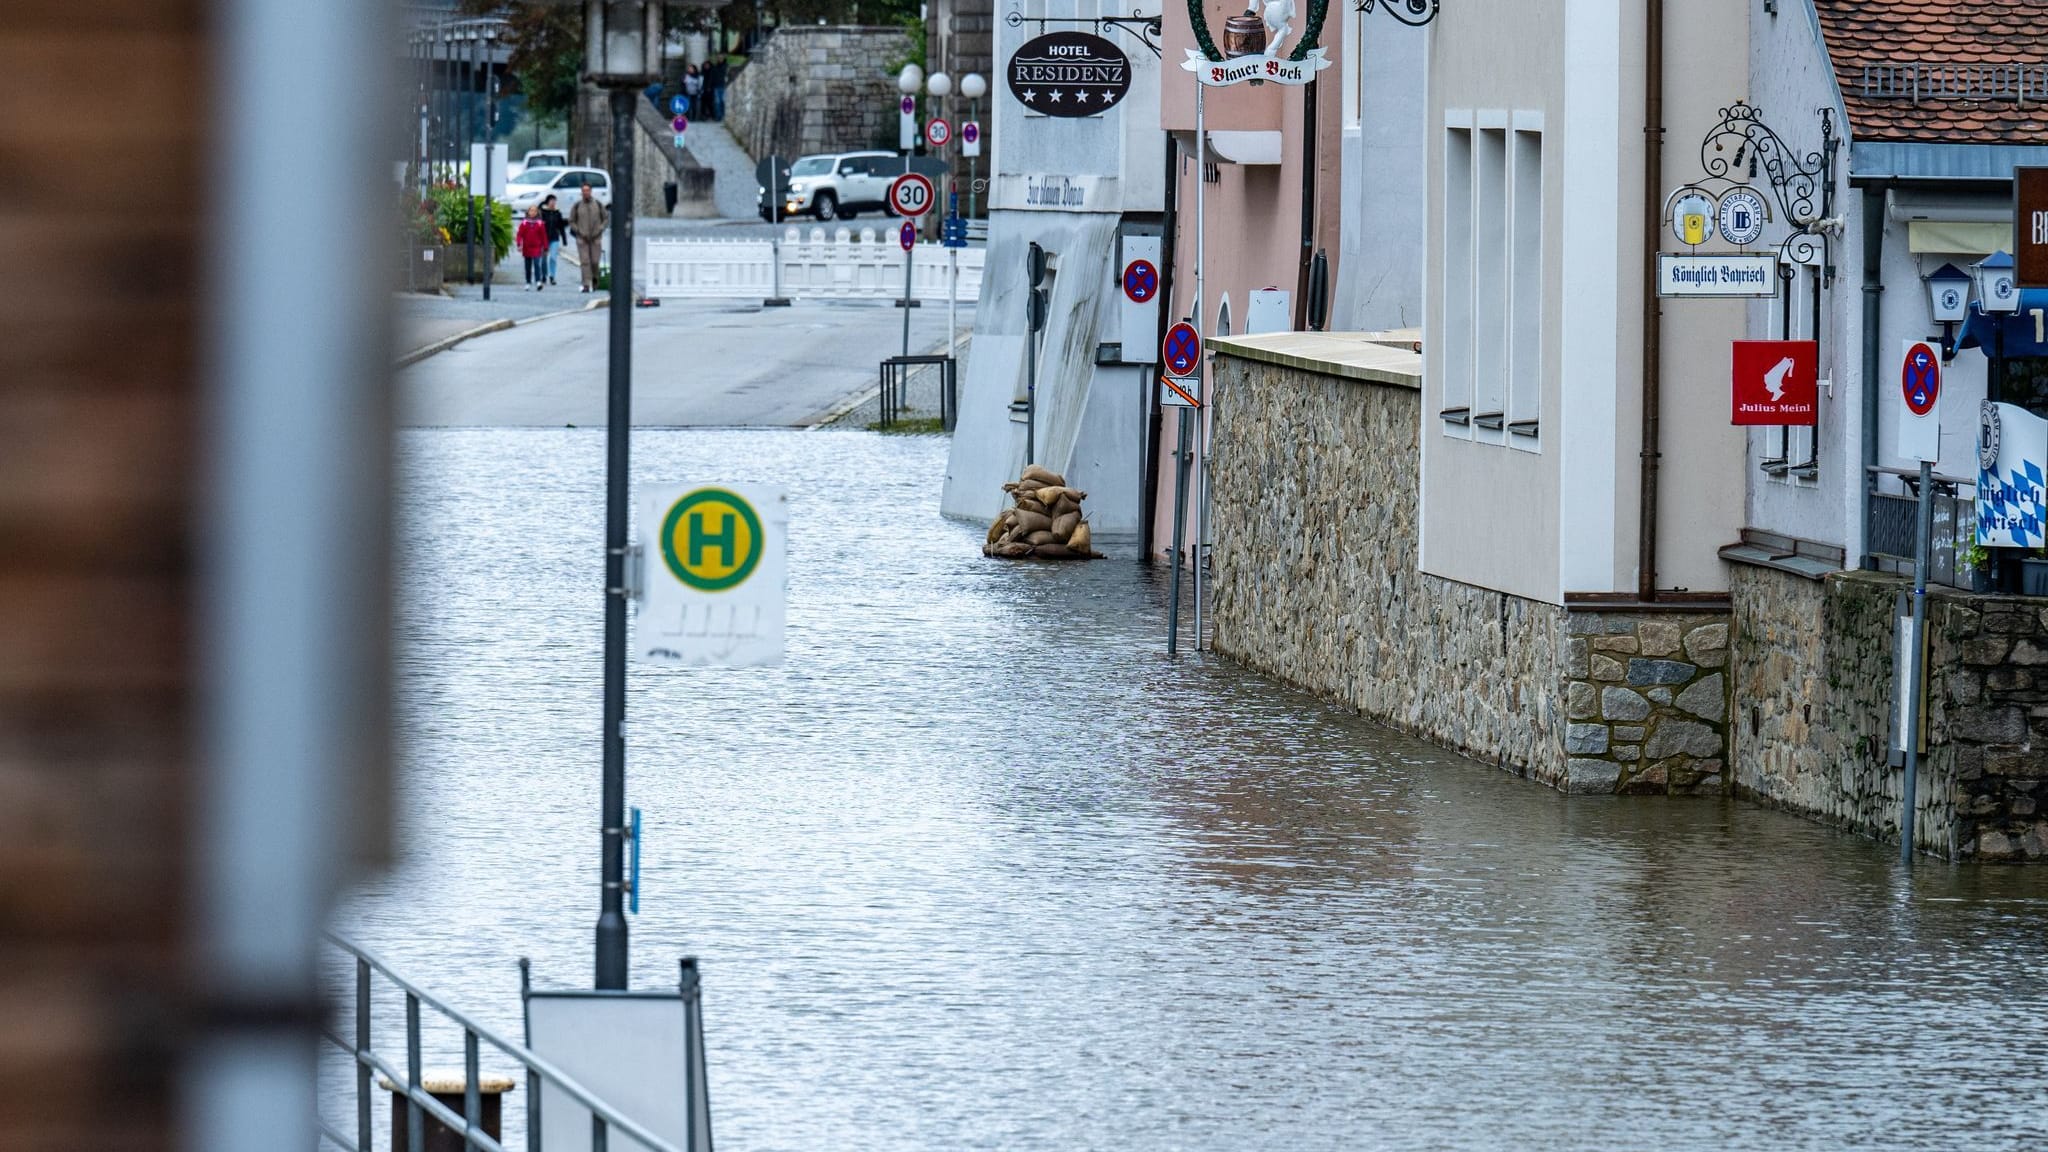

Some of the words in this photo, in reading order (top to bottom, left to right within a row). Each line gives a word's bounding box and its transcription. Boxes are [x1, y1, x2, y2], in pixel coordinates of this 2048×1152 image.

[1049, 46, 1091, 56] HOTEL
[1016, 66, 1123, 81] RESIDENZ
[1211, 64, 1259, 82] Blauer
[1266, 60, 1302, 80] Bock
[932, 126, 946, 139] 30
[900, 185, 925, 205] 30
[1672, 265, 1717, 288] Königlich
[1720, 265, 1765, 288] Bayrisch
[1740, 403, 1776, 412] Julius
[1779, 403, 1811, 413] Meinl
[689, 513, 735, 567] H
